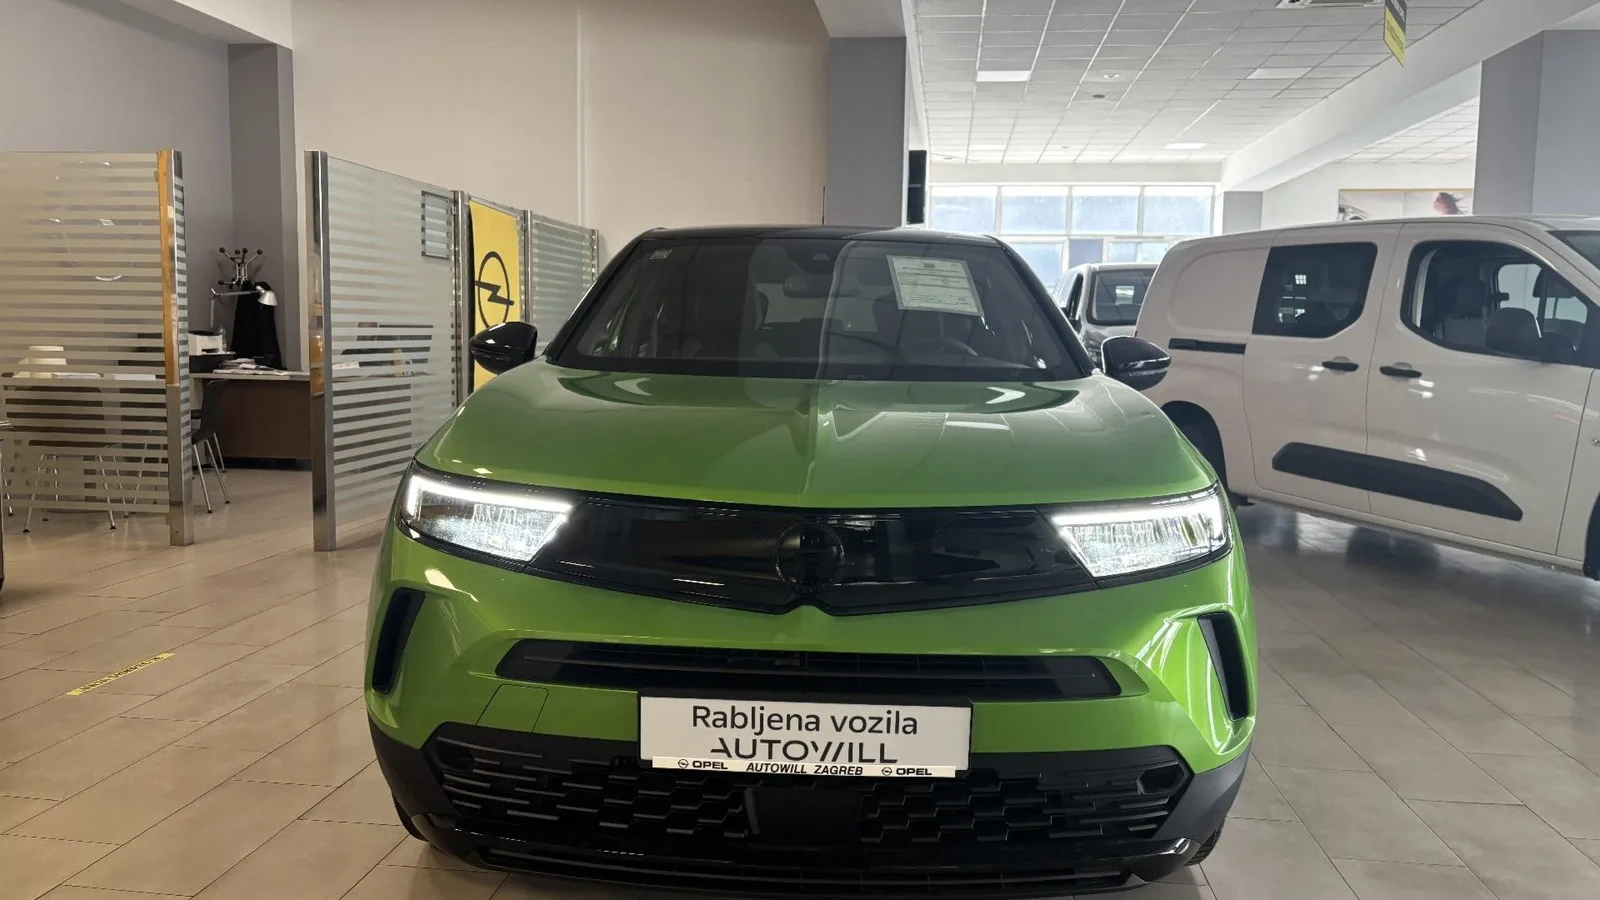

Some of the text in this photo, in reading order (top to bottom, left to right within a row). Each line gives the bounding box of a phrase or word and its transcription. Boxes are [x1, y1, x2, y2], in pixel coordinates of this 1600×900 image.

[692, 705, 918, 735] Rabljena vozila
[710, 737, 898, 763] AUTOWILL
[692, 760, 932, 776] OPEL AUTOWILL ZAGREB OPEL
